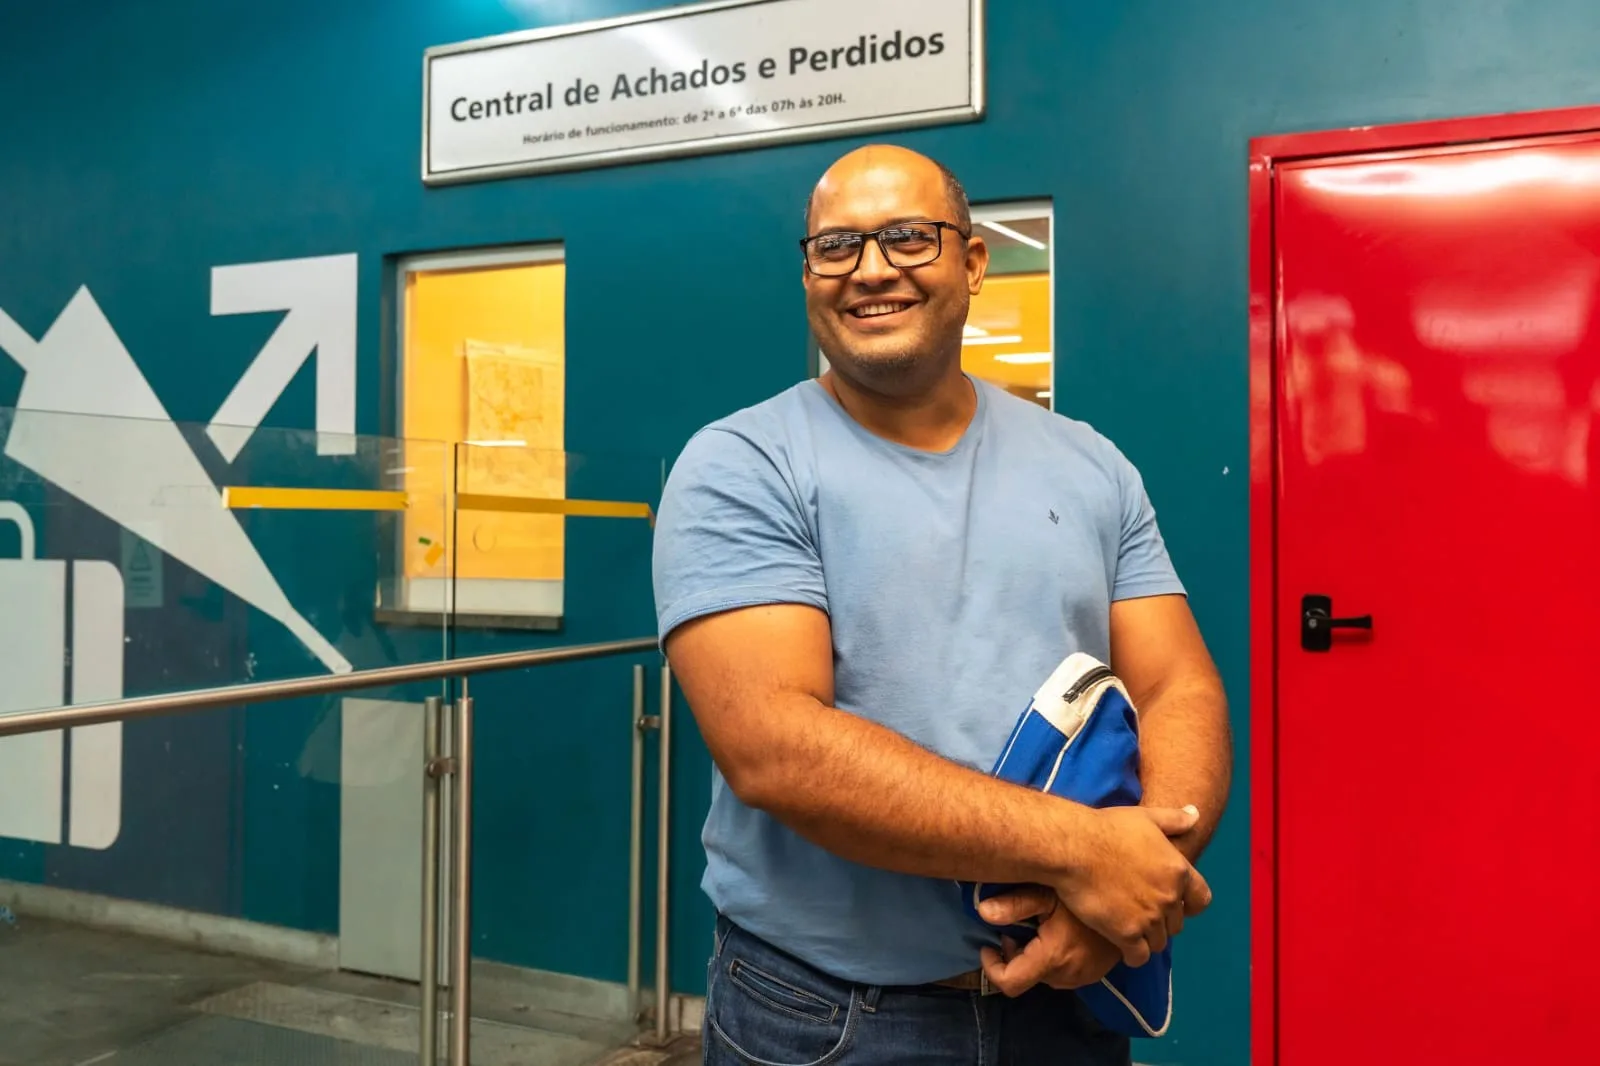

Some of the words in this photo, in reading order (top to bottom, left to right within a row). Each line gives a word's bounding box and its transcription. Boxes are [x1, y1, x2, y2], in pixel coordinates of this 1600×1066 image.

[450, 82, 553, 122] Central
[564, 78, 601, 107] de
[611, 62, 747, 100] Achados
[758, 57, 779, 80] e
[788, 31, 945, 76] Perdidos
[523, 130, 565, 145] Horário
[567, 127, 583, 139] de
[586, 115, 680, 137] funcionamento:
[683, 113, 699, 124] de
[718, 111, 726, 120] a
[746, 103, 768, 116] das
[771, 98, 796, 113] 07h
[799, 98, 814, 109] às
[817, 92, 846, 107] 20H.
